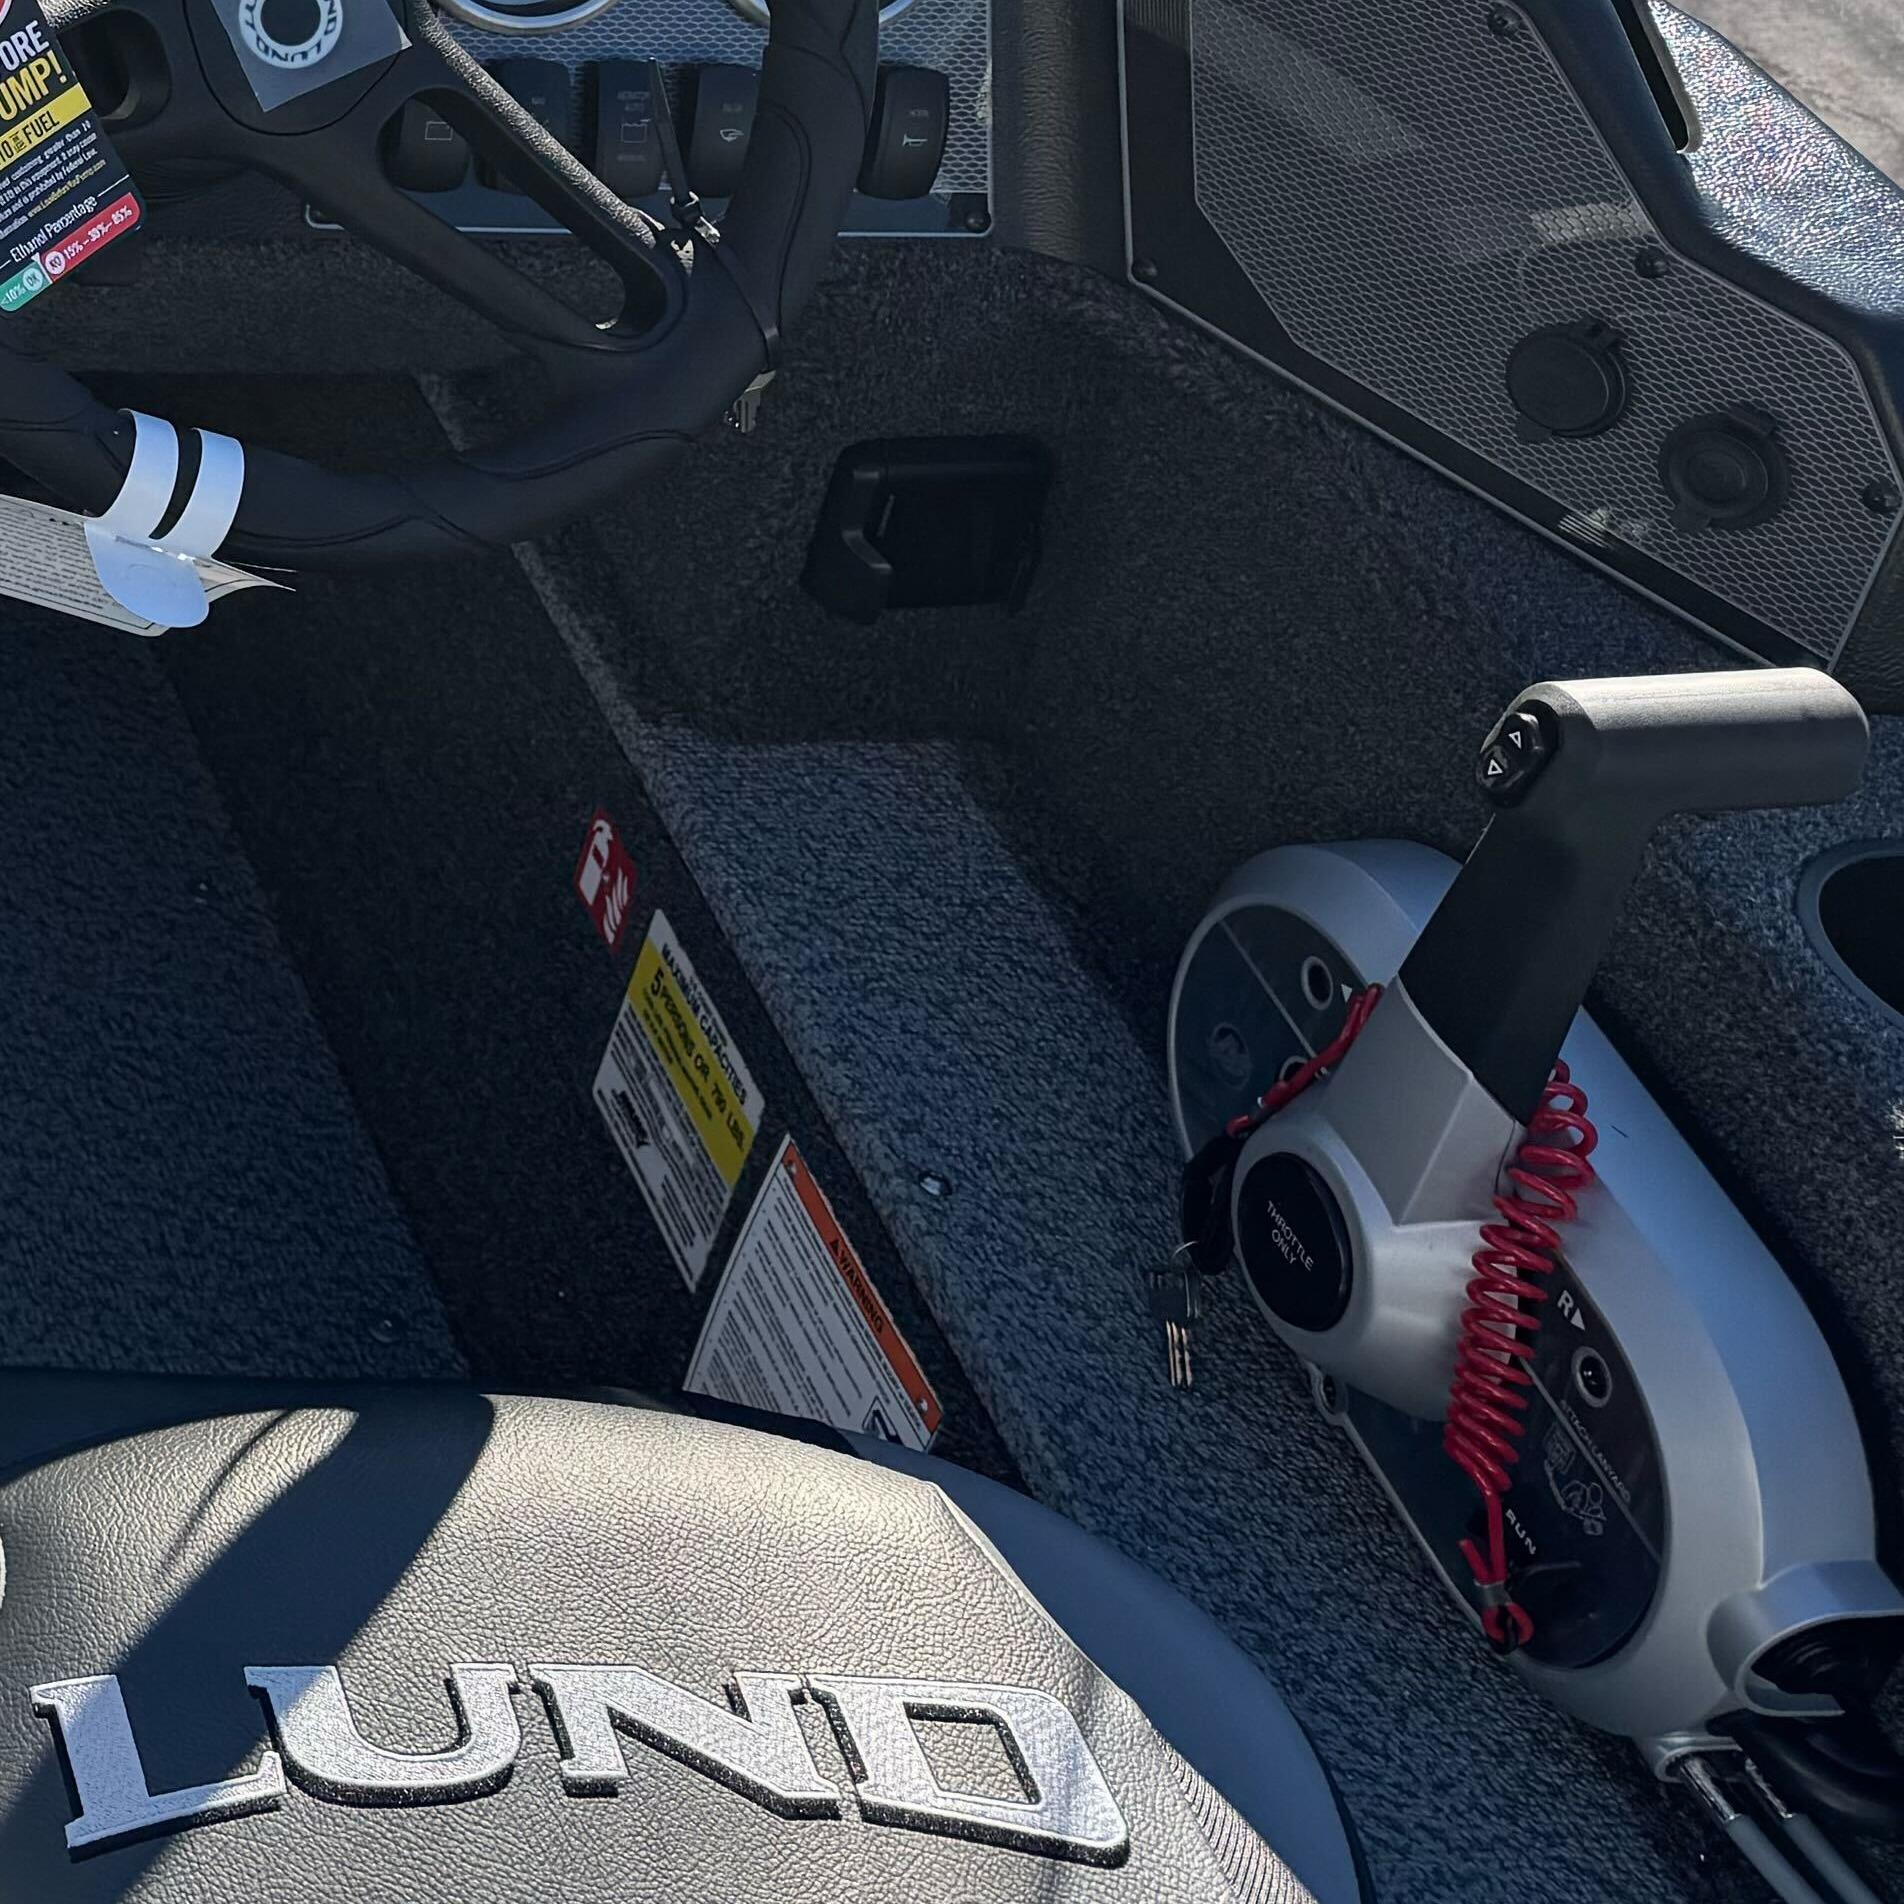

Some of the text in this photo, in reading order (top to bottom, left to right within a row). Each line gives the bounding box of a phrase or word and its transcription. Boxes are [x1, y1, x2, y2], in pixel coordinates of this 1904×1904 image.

[256, 37, 322, 62] LUND
[22, 110, 60, 144] FUEL
[10, 196, 98, 262] Ethanol Percentage
[650, 964, 664, 999] 5
[660, 941, 700, 1018] MAXIMUM
[698, 1010, 748, 1106] CAPACITIES
[1266, 1200, 1314, 1272] THROTTLE
[1272, 1229, 1296, 1264] ONLY
[838, 1251, 885, 1336] WARNING
[1556, 1290, 1574, 1318] R
[1505, 1509, 1537, 1555] RUN
[31, 1664, 1130, 1864] LUND
